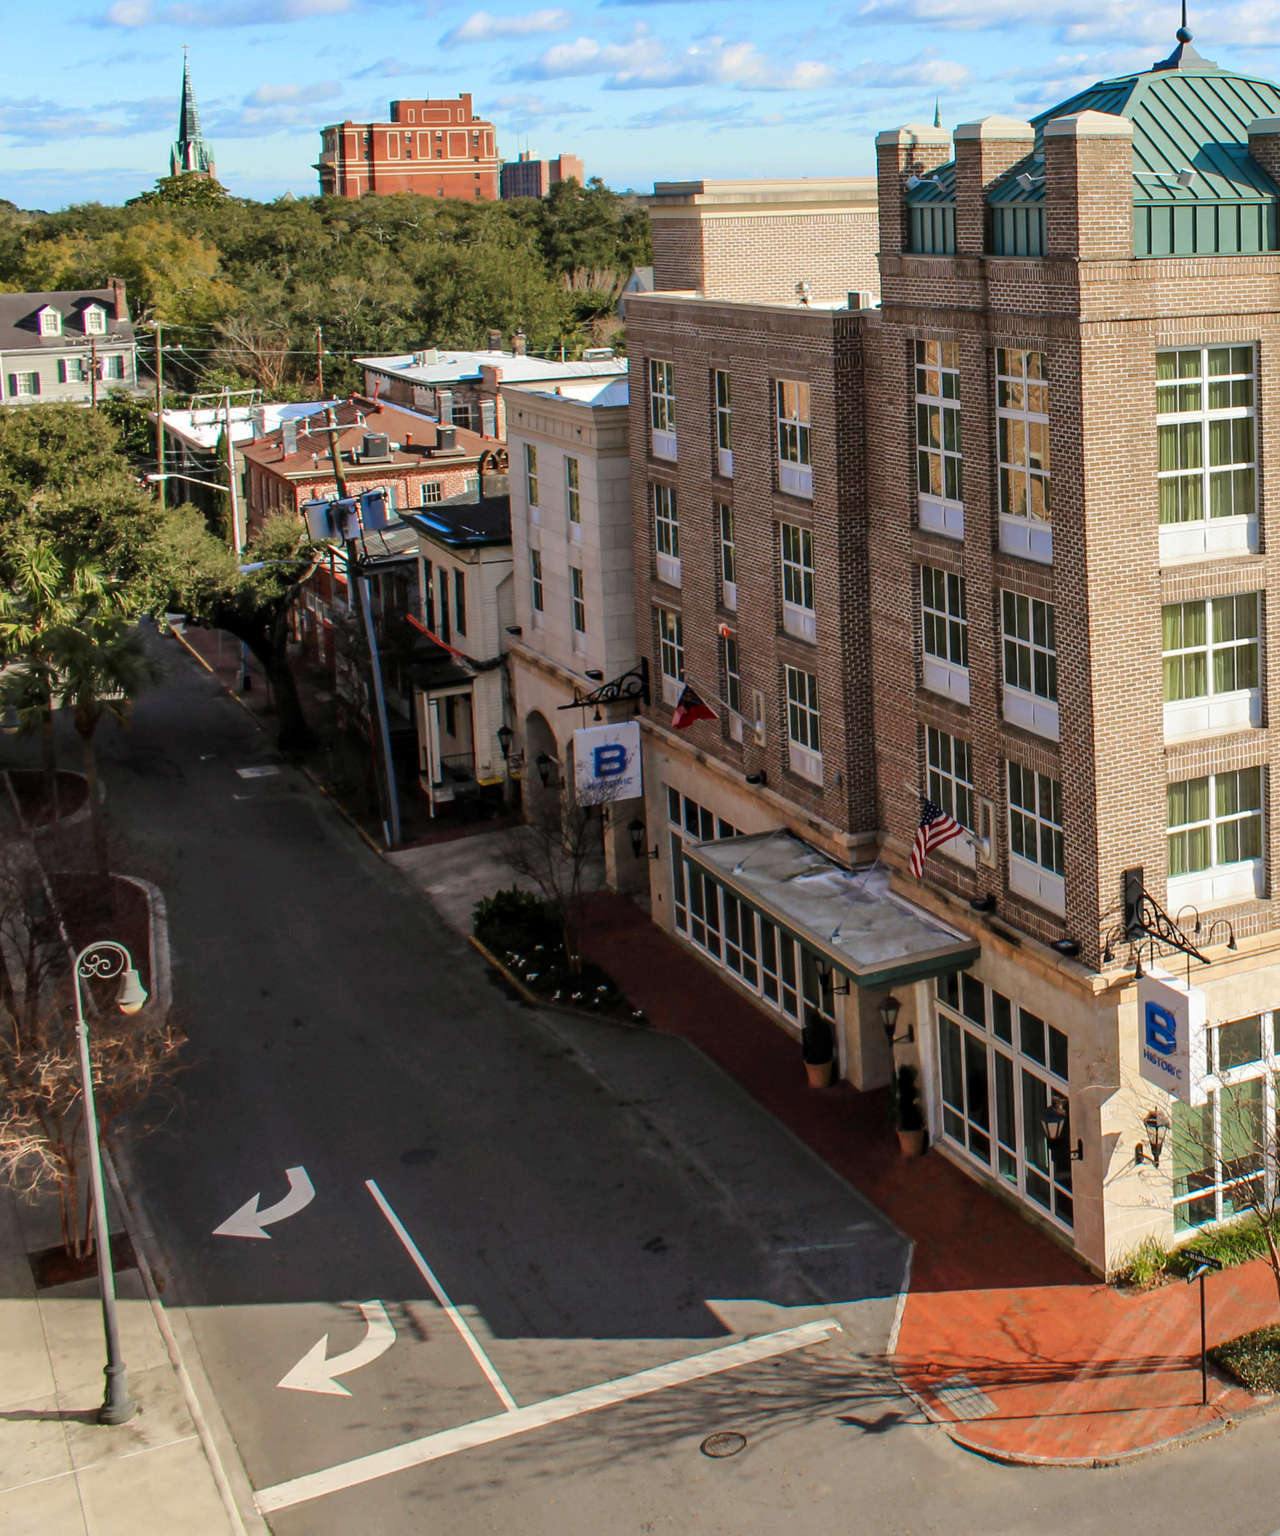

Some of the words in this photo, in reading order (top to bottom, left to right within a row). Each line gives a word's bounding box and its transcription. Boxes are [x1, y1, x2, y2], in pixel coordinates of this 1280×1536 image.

[593, 744, 627, 777] B
[1145, 1001, 1176, 1056] B
[1143, 1048, 1182, 1080] HISTORIC
